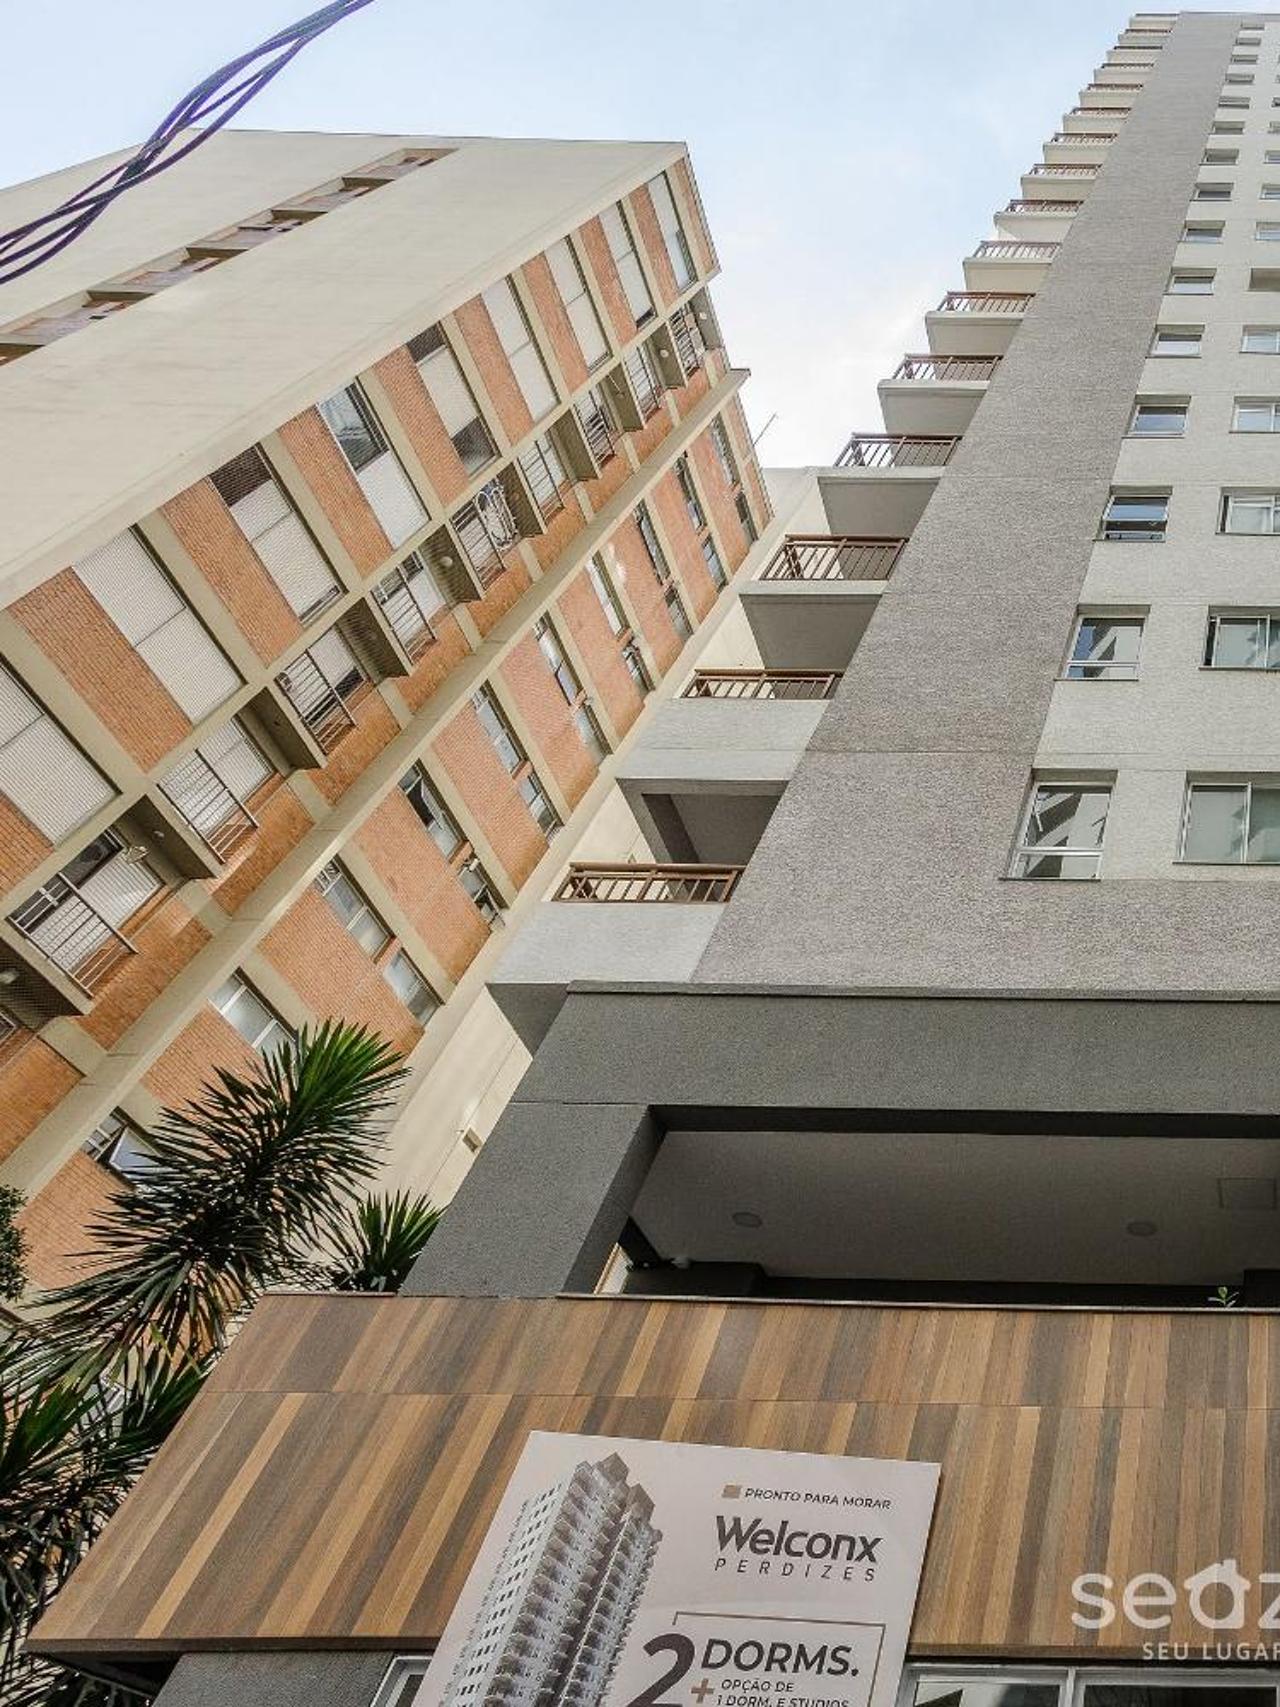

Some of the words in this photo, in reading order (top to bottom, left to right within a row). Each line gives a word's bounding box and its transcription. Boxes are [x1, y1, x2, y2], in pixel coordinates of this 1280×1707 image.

[744, 1487, 801, 1502] PRONTO
[803, 1493, 839, 1506] PARA
[842, 1496, 892, 1510] MORAR
[715, 1514, 884, 1563] Welconx
[714, 1557, 876, 1583] PERDIZES
[626, 1633, 695, 1707] 2
[701, 1638, 859, 1677] DORMS.
[721, 1678, 771, 1693] OPÇÃO
[774, 1681, 795, 1693] DE
[776, 1698, 787, 1707] E
